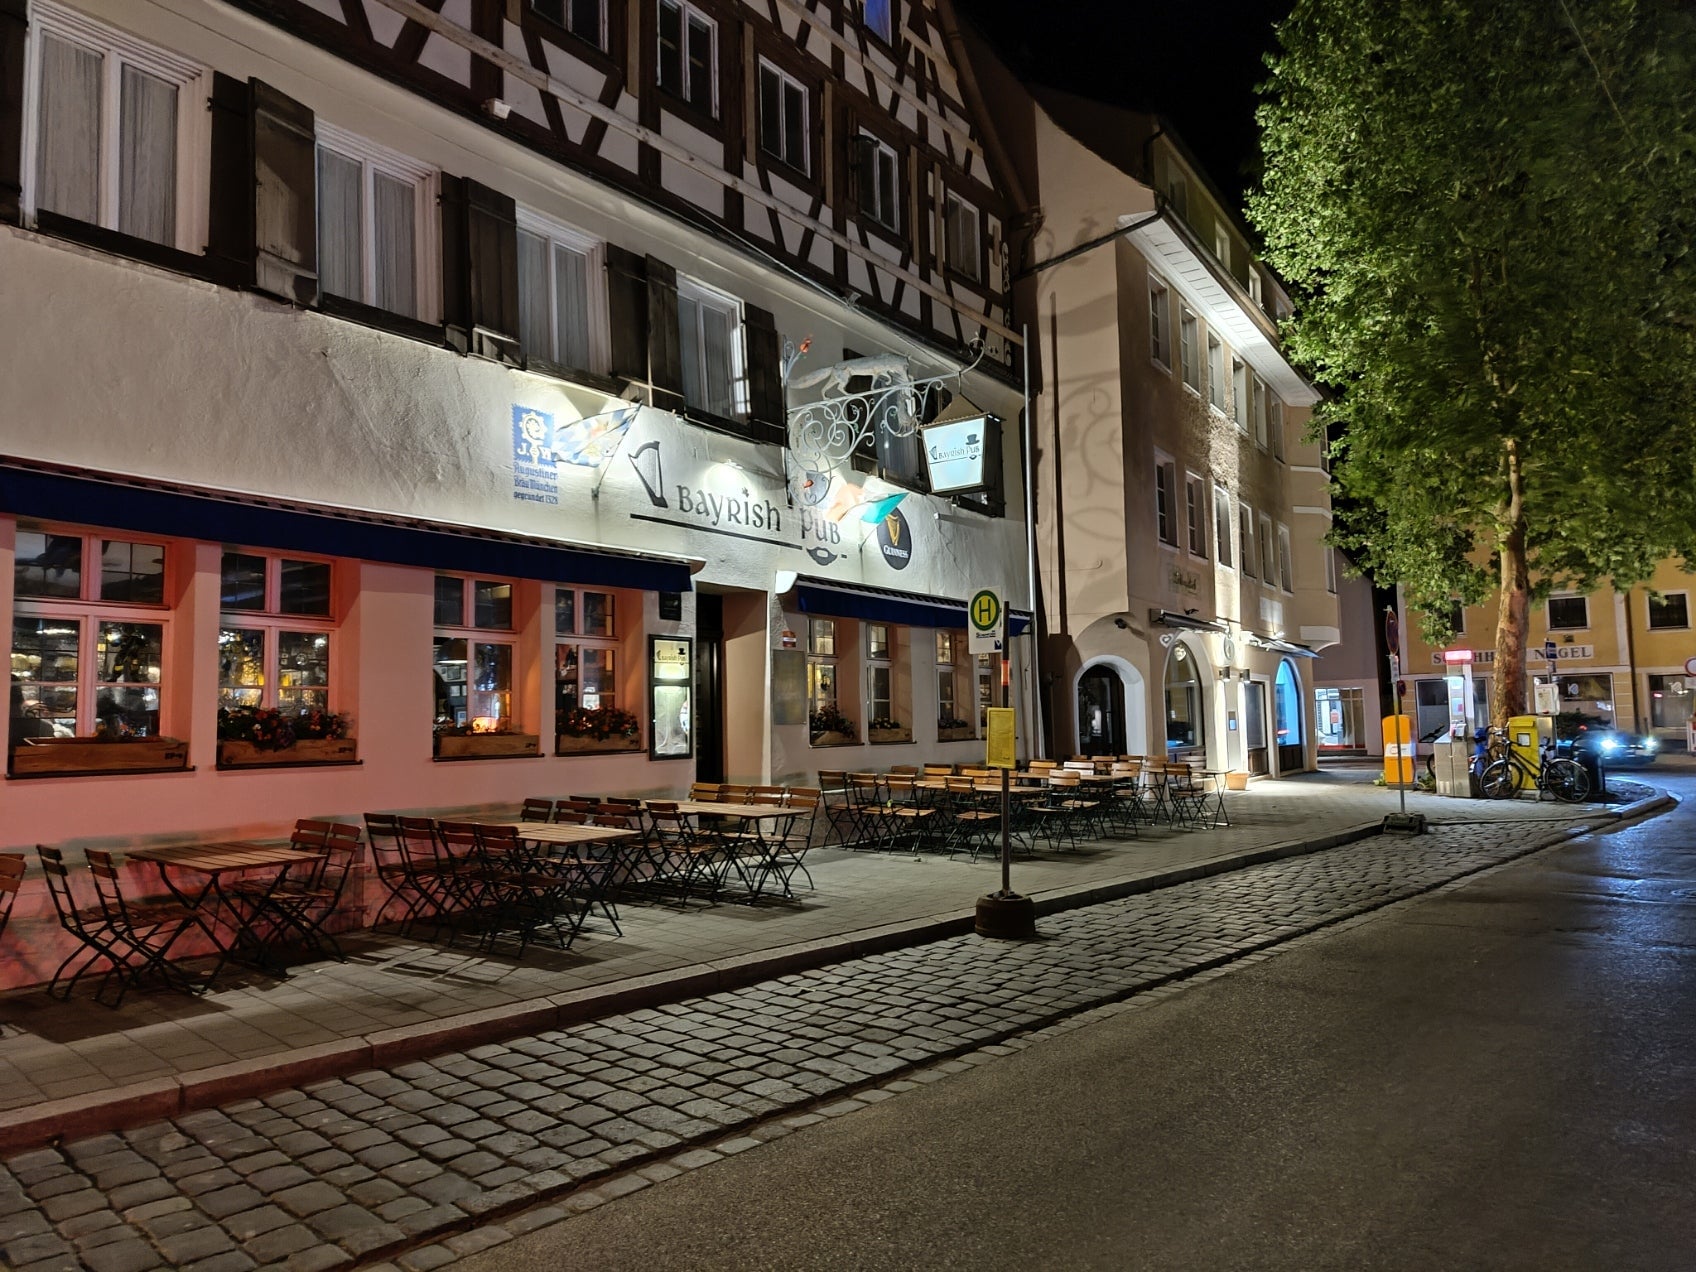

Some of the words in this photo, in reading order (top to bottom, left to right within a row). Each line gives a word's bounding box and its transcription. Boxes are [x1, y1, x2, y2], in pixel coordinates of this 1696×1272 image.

[513, 462, 558, 480] Augustiner
[978, 598, 991, 623] H
[1535, 647, 1592, 660] NGEL
